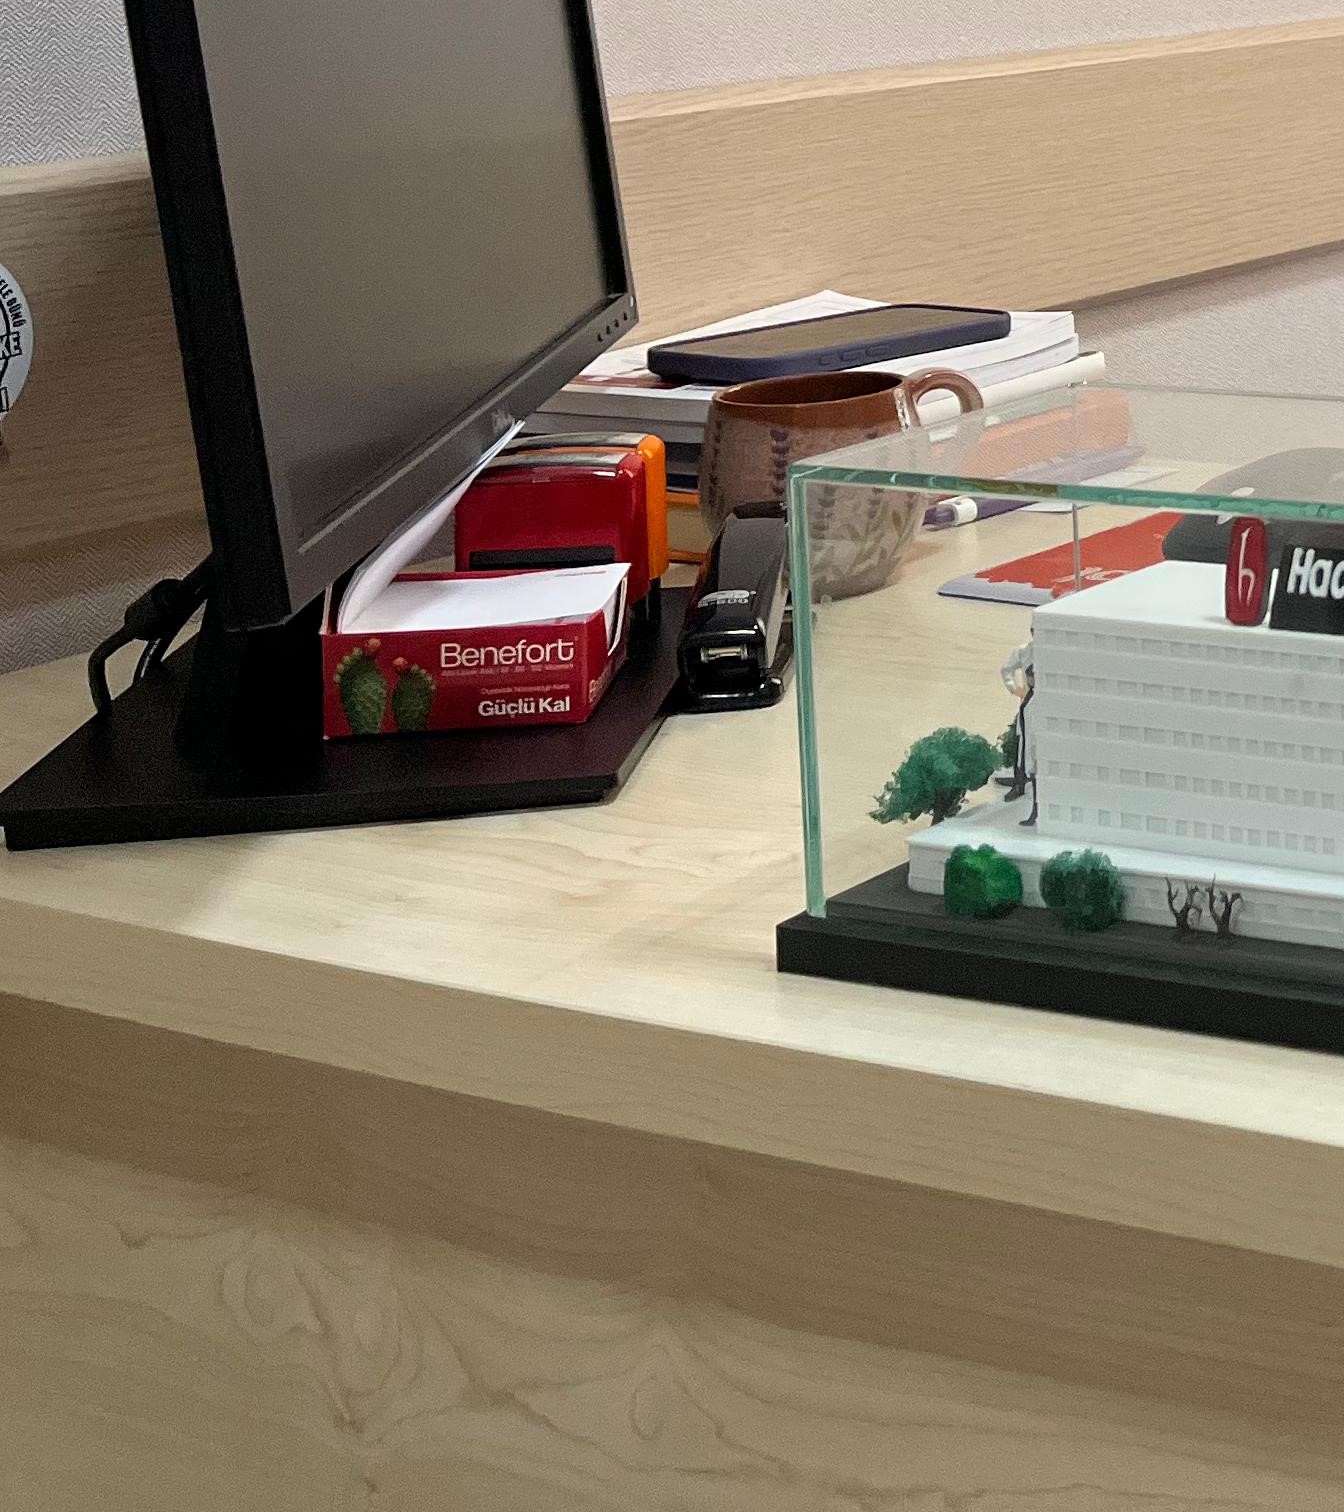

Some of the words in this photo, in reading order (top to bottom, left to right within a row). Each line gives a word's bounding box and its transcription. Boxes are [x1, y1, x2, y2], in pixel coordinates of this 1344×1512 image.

[440, 638, 574, 668] Benefort
[478, 697, 535, 718] Güçlü
[539, 695, 571, 713] Kal
